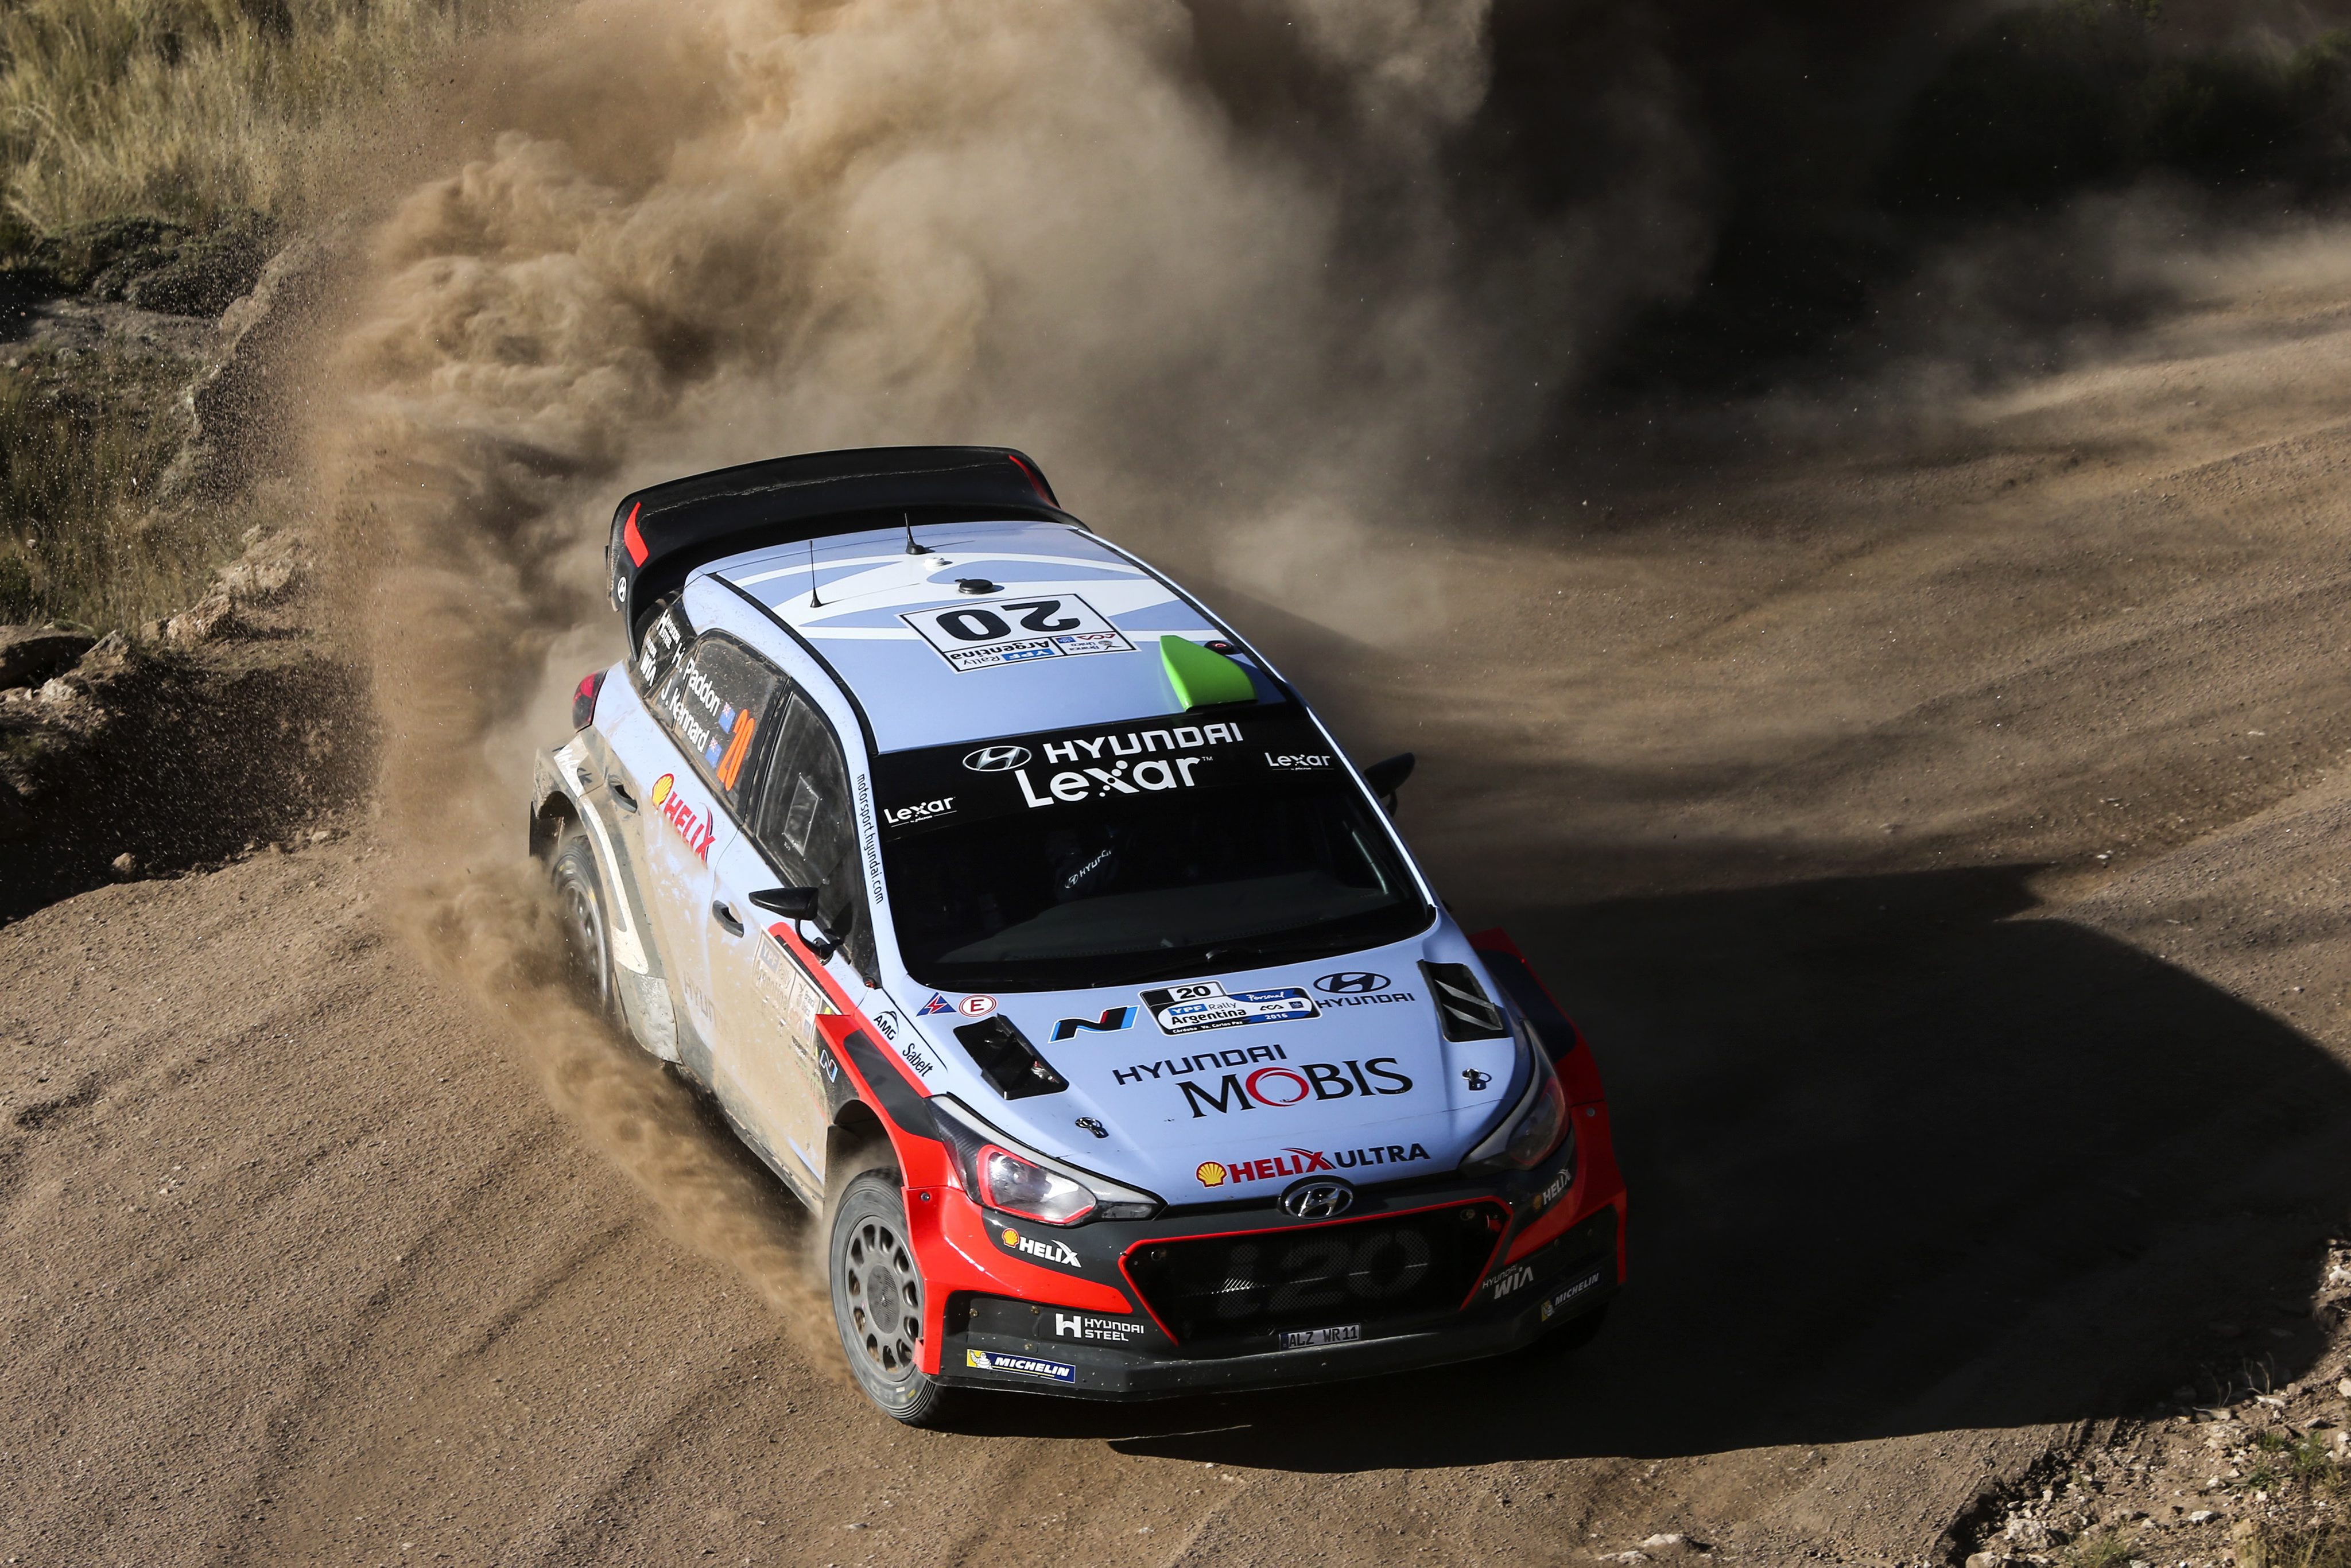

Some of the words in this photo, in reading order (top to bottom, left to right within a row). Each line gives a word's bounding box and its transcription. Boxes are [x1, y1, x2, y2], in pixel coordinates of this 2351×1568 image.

[936, 600, 1081, 641] 20
[661, 628, 672, 650] STEEL
[951, 639, 1049, 661] Argentina
[963, 655, 1000, 666] Rally
[1009, 649, 1050, 660] YPF
[682, 657, 720, 717] Paddon
[661, 678, 672, 707] J.
[669, 688, 711, 752] Kennard
[717, 709, 755, 791] 20
[1042, 723, 1243, 763] HYUNDAI
[1264, 752, 1331, 769] Lexar
[884, 797, 954, 824] Lexar
[664, 790, 716, 869] HELIX
[857, 774, 884, 905] motorsport.hyundai.com
[971, 999, 984, 1012] E
[1176, 985, 1211, 999] 20
[1246, 992, 1285, 1001] Personal
[1314, 992, 1415, 1008] HYUNDAI
[1170, 1005, 1204, 1015] YPF
[1208, 1002, 1236, 1011] Rally
[1171, 1008, 1247, 1025] Argentina
[874, 1012, 897, 1041] AMG
[902, 1043, 933, 1077] Sabelt
[1112, 1044, 1288, 1085] HYUNDAI
[1176, 1057, 1414, 1119] MOBIS
[1227, 1147, 1336, 1183] HELIX
[1334, 1143, 1430, 1169] ULTRA
[1543, 1169, 1572, 1205] HELIX
[1019, 1237, 1082, 1268] HELIX
[1482, 1264, 1518, 1289] HYUNDAI
[1494, 1266, 1534, 1299] WIA
[1554, 1273, 1599, 1306] MICHELIN
[1084, 1318, 1144, 1334] HYUNDAI
[1084, 1330, 1129, 1342] STEEL
[1289, 1331, 1314, 1348] ALZ
[1323, 1326, 1358, 1343] WR11
[994, 1356, 1070, 1377] MICHELIN
